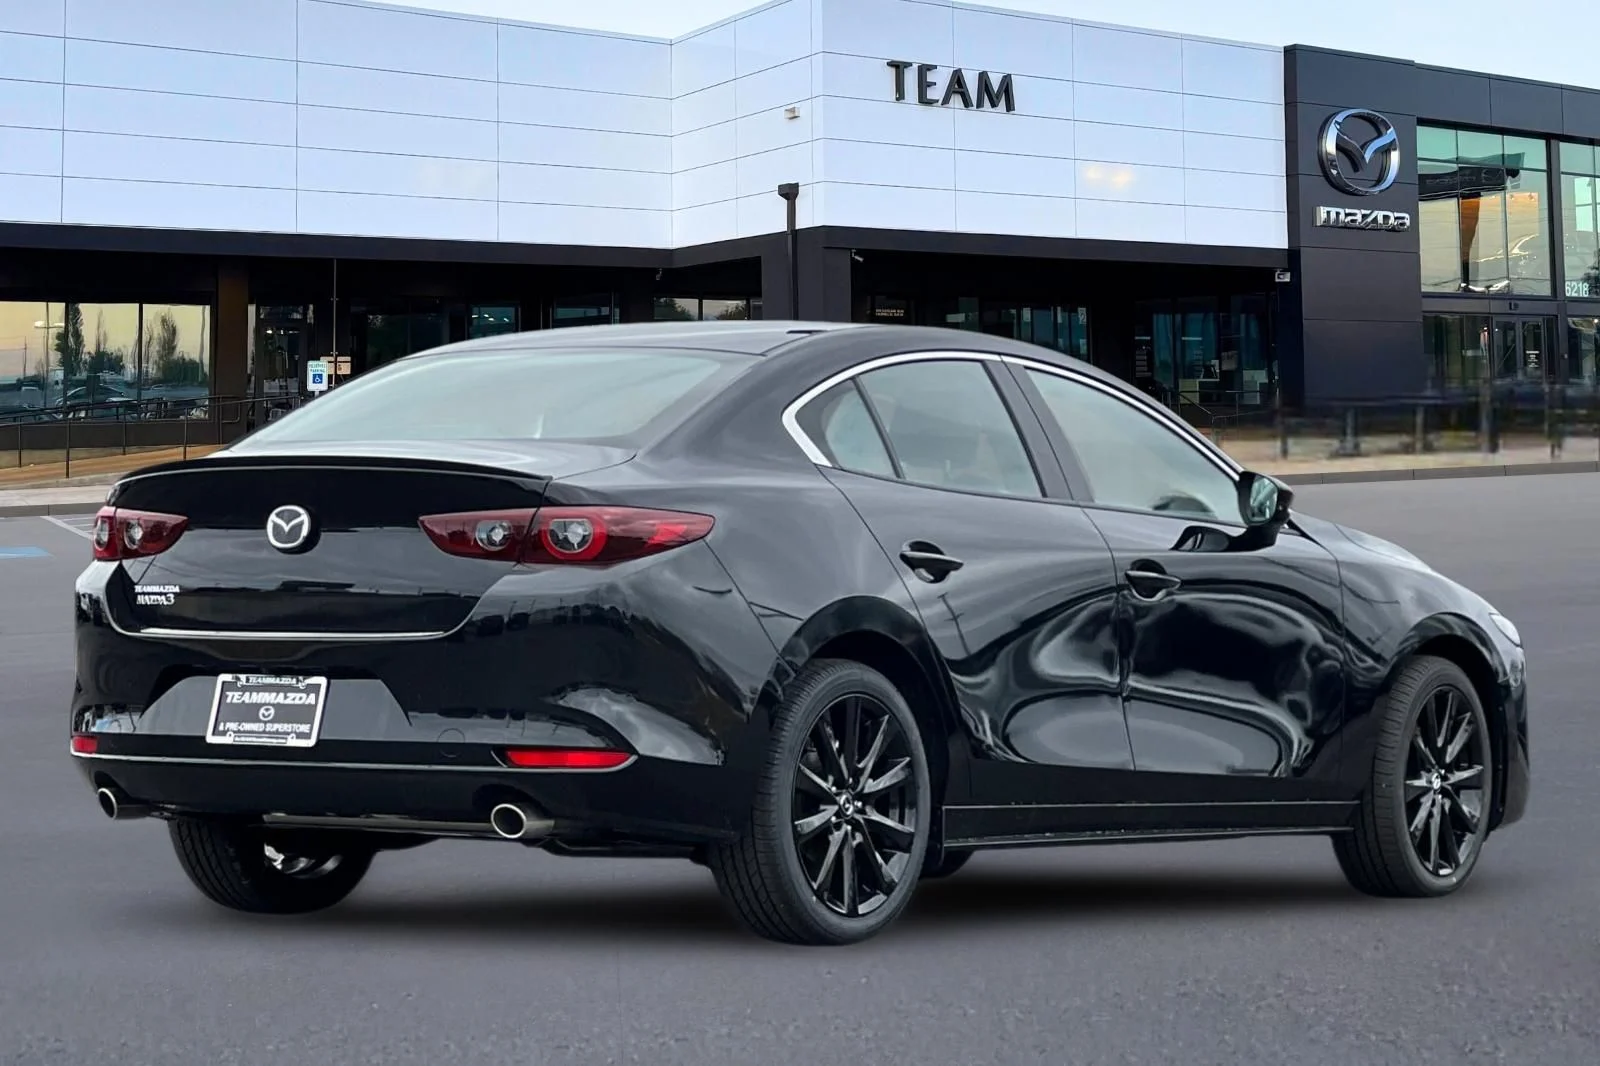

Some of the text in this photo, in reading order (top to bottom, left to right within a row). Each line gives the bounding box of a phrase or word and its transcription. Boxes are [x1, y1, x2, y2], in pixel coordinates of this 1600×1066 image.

[886, 60, 1015, 113] TEAM
[1565, 281, 1589, 297] 6218
[225, 691, 316, 705] TEAMMAZDA
[265, 723, 311, 733] SUPERSTORE
